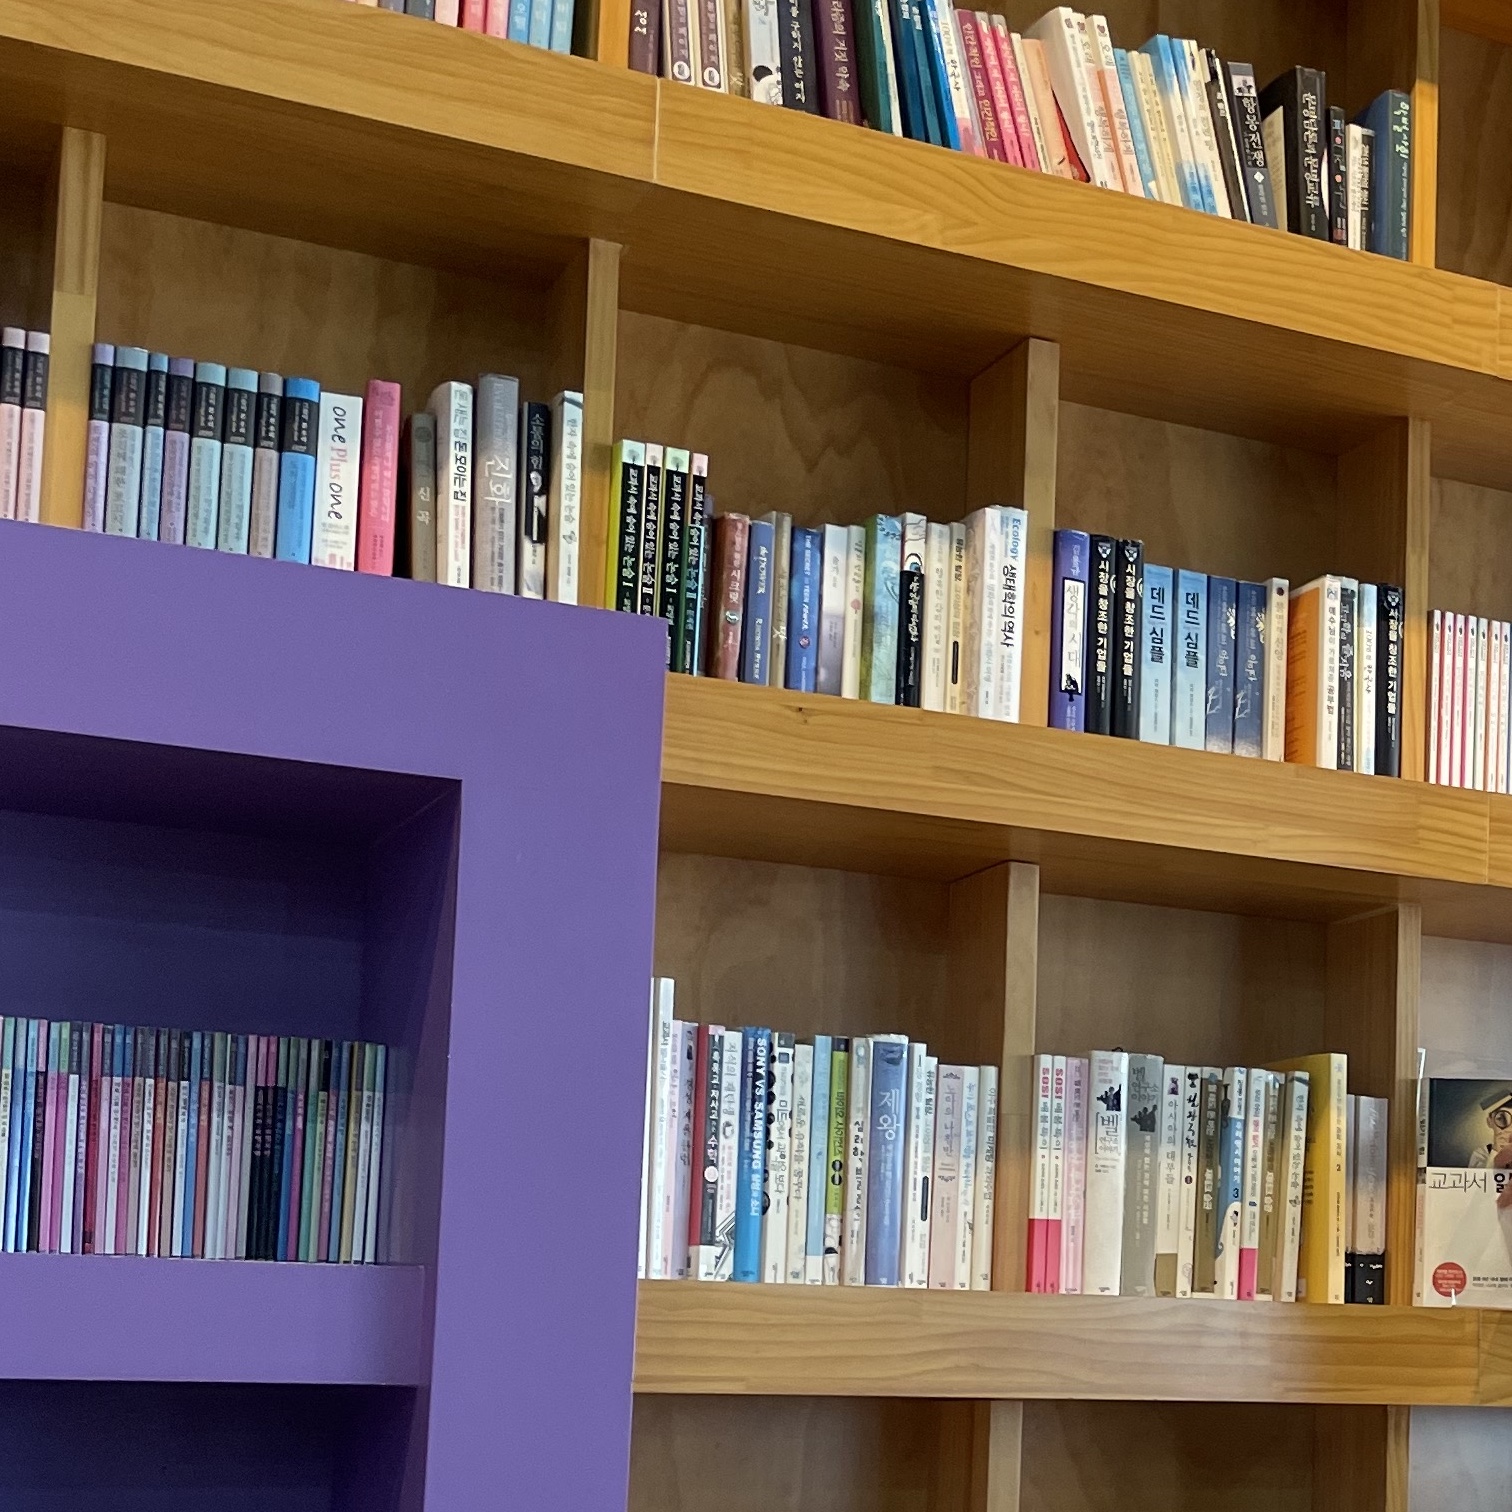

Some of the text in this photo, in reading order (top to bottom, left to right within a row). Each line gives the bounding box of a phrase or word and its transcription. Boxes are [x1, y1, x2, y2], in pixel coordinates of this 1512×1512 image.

[327, 406, 348, 520] one Plus one
[453, 440, 467, 502] 돈 모이는 집
[484, 455, 512, 504] 진화
[565, 484, 576, 502] 있는
[693, 484, 704, 510] 교과서
[565, 505, 575, 524] 논술
[622, 468, 639, 580] 교과서 속에 숨어 있는 논술
[642, 473, 658, 584] 교과서 속에 숨어 있는 논술
[666, 474, 683, 585] 교과서 속에 숨어 있는 논술
[688, 548, 700, 564] 있는
[1009, 518, 1021, 562] Ecology
[687, 568, 699, 590] 논술
[755, 556, 766, 594] POWER
[803, 549, 811, 576] SECRET
[1001, 564, 1017, 648] 생태학의 역사
[1096, 560, 1109, 673] 시장을 창조한 기업들
[1122, 563, 1136, 677] 시장을 창조한 기업들
[1150, 587, 1165, 663] 데드 심플
[1389, 608, 1399, 641] 시장을
[1184, 592, 1200, 668] 데드 심플
[1067, 632, 1081, 668] 시대
[1387, 680, 1397, 714] 기업들
[723, 1042, 736, 1115] 지식의 재탄생
[752, 1037, 766, 1169] SONY VS SAMSUNG
[796, 1095, 806, 1128] 새로운
[876, 1088, 900, 1141] 제왕
[1101, 1115, 1118, 1136] 벨
[1165, 1099, 1178, 1184] 아시아의 대부들
[1292, 1152, 1302, 1169] 있는
[774, 1174, 785, 1193] 보다
[1233, 1188, 1239, 1198] 3
[1291, 1171, 1301, 1189] 논술
[1427, 1172, 1487, 1192] 교과서
